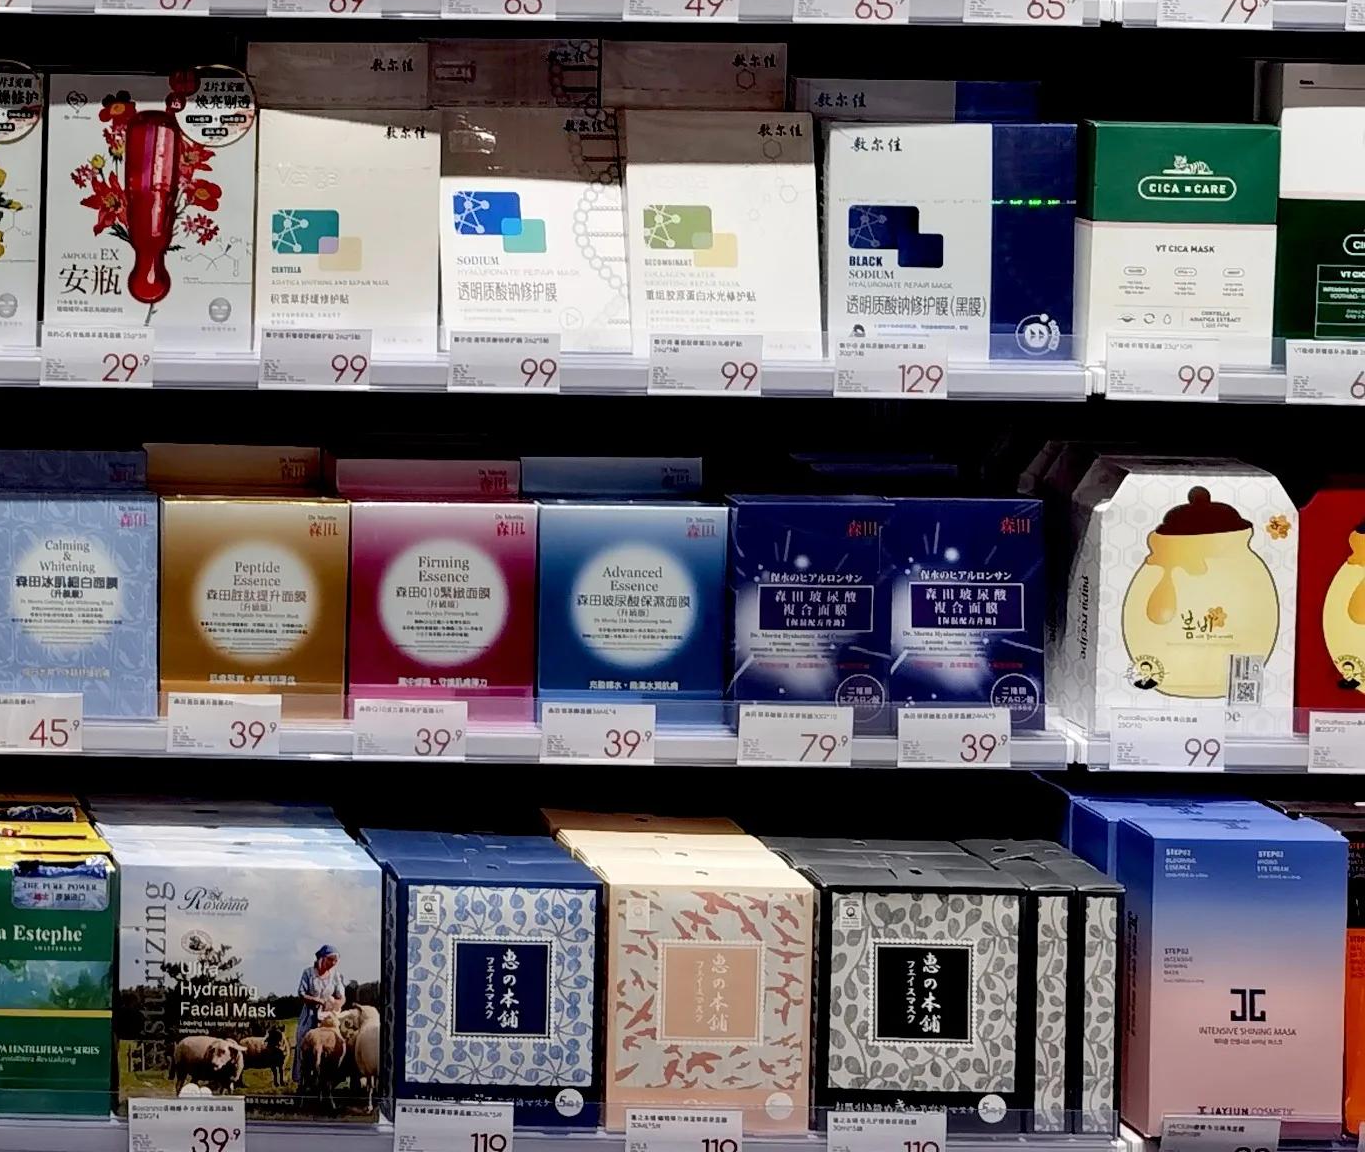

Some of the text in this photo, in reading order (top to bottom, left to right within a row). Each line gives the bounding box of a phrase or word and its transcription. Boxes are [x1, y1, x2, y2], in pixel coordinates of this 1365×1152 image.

[1148, 182, 1228, 195] CICA CARE
[1156, 245, 1215, 254] VT CICA MASK
[457, 256, 499, 265] SODIUM
[849, 255, 883, 267] BLACK
[58, 264, 122, 296] 安瓶
[849, 270, 894, 279] SODIUM
[457, 282, 557, 302] 透明质酸钠修护膜
[898, 364, 944, 394] 129
[1000, 517, 1030, 534] 森田
[45, 540, 90, 554] Calming
[39, 561, 95, 575] Whitening
[235, 561, 280, 576] Peptide
[418, 556, 469, 571] Firming
[603, 565, 663, 578] Advanced
[233, 575, 281, 586] Essence
[611, 580, 658, 591] Essence
[783, 604, 848, 617] 複合面膜
[1183, 739, 1221, 767] 99
[14, 925, 83, 945] Estephe
[180, 961, 218, 976] Ultra
[180, 982, 257, 1001] Hydrating
[906, 960, 917, 1023] フェイスマスク
[921, 953, 941, 1033] 恵の本舗
[180, 1002, 275, 1018] Facial Mask
